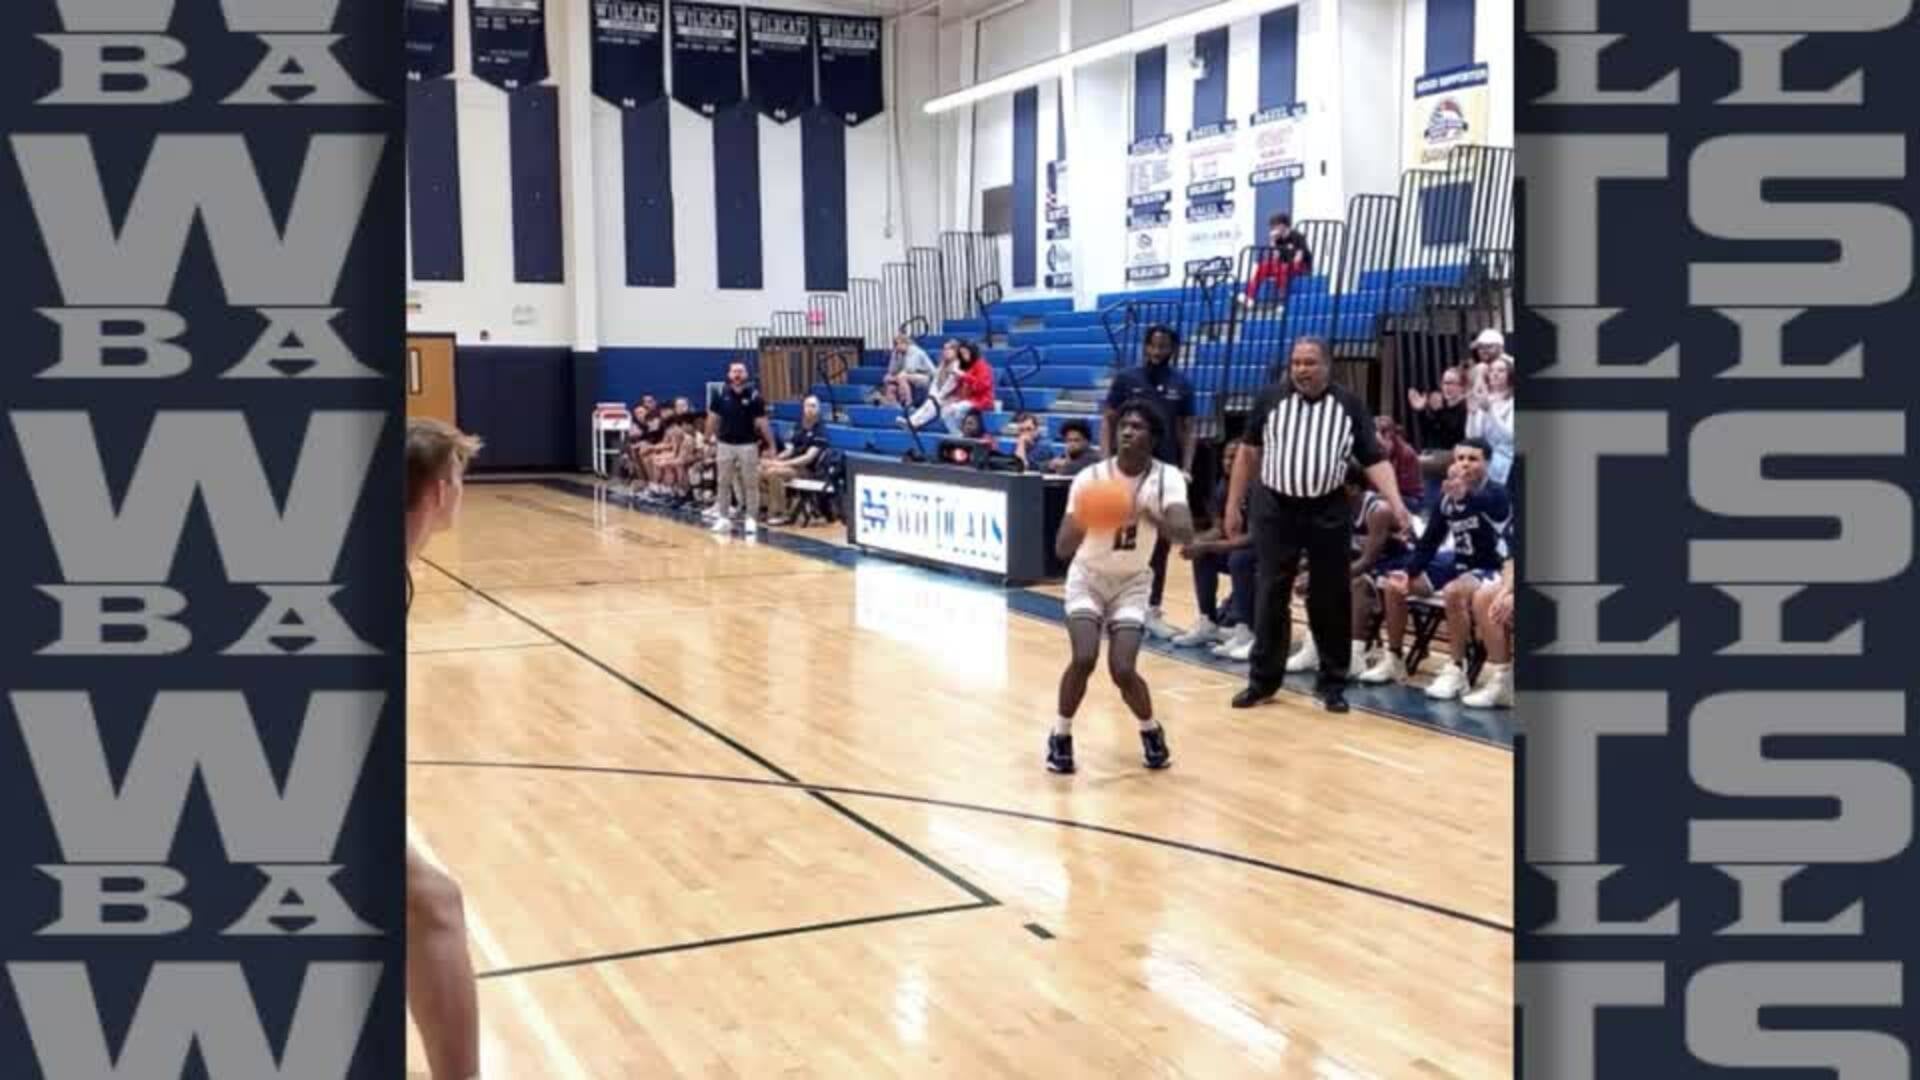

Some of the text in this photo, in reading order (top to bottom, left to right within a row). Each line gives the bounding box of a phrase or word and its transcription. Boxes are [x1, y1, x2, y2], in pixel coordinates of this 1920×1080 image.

[594, 3, 660, 25] WILDCATS
[674, 6, 738, 30] WILDCATS
[748, 11, 810, 35] WILDCATS
